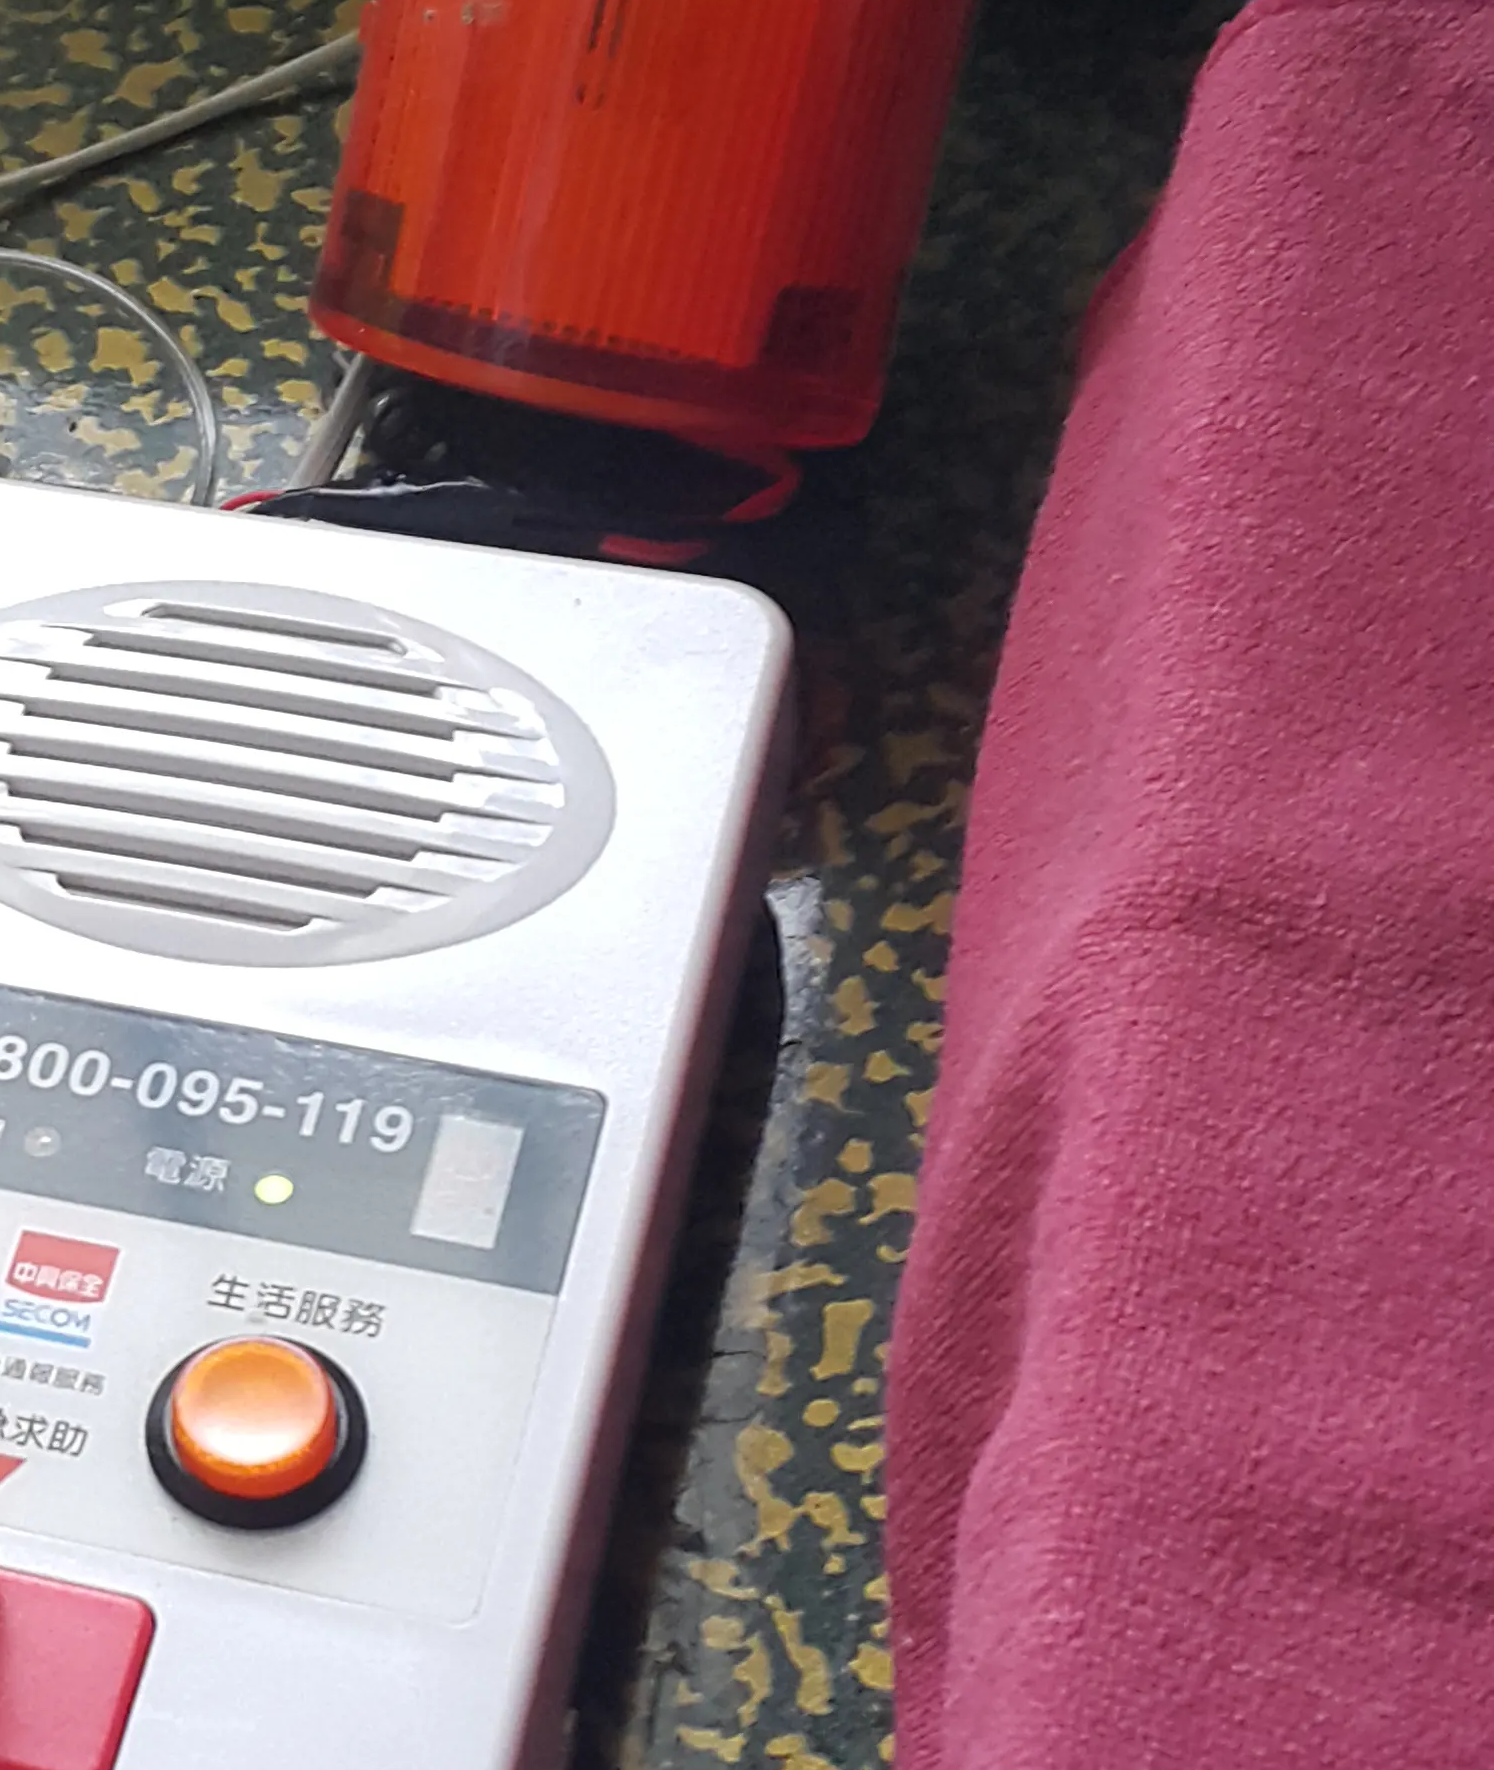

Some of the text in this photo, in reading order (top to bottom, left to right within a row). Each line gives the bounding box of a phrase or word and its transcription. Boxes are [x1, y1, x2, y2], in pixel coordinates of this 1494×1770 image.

[144, 1145, 232, 1193] 電源
[1, 1298, 92, 1332] SECOM
[206, 1273, 387, 1338] 生活服務
